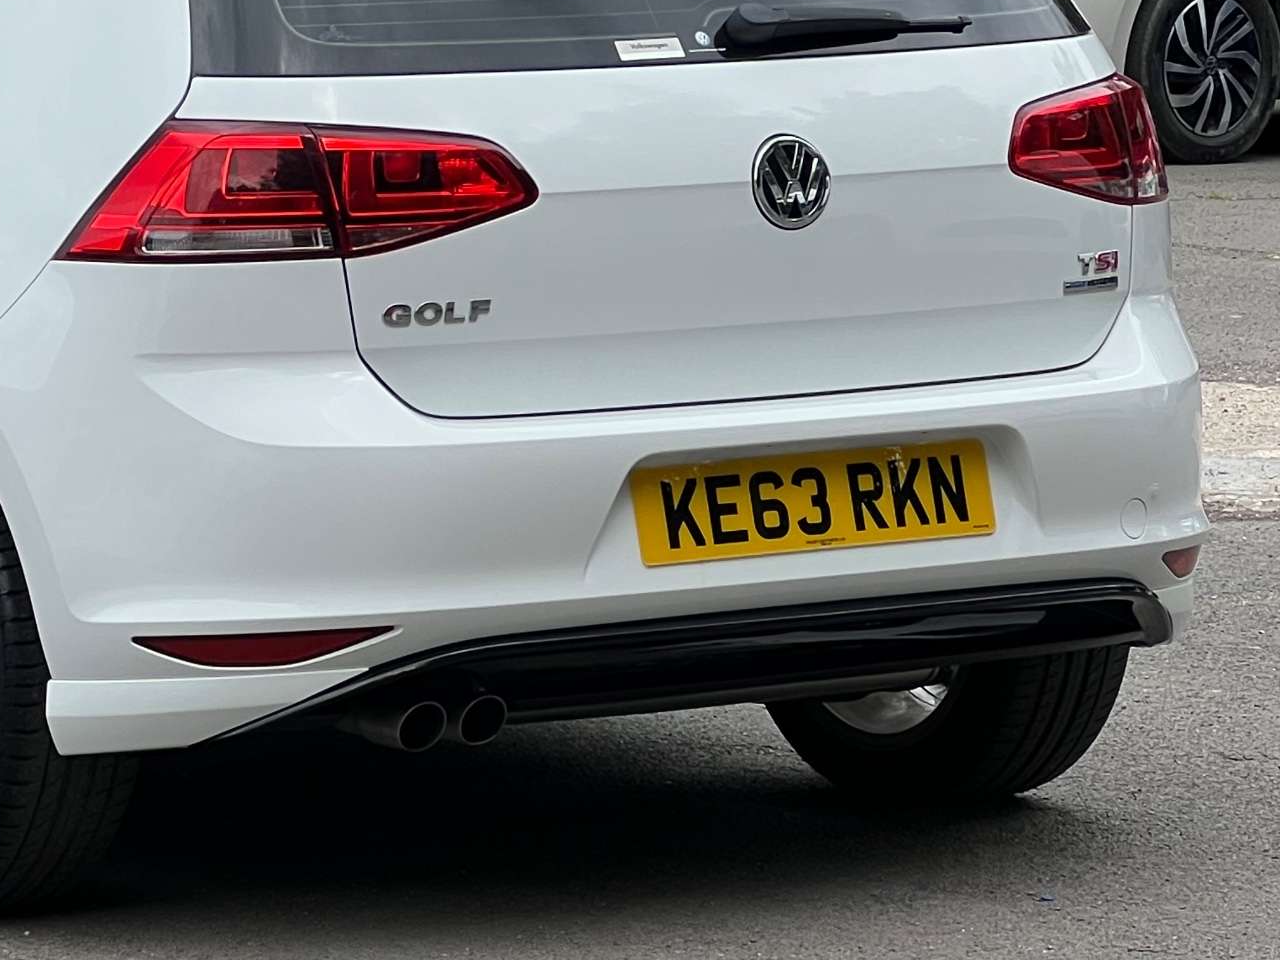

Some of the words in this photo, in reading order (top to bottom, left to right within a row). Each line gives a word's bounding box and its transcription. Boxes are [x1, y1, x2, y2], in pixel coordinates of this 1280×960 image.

[1077, 249, 1120, 276] TSI
[381, 299, 492, 329] GOLF
[660, 466, 833, 550] KE63
[846, 454, 970, 533] RKN
